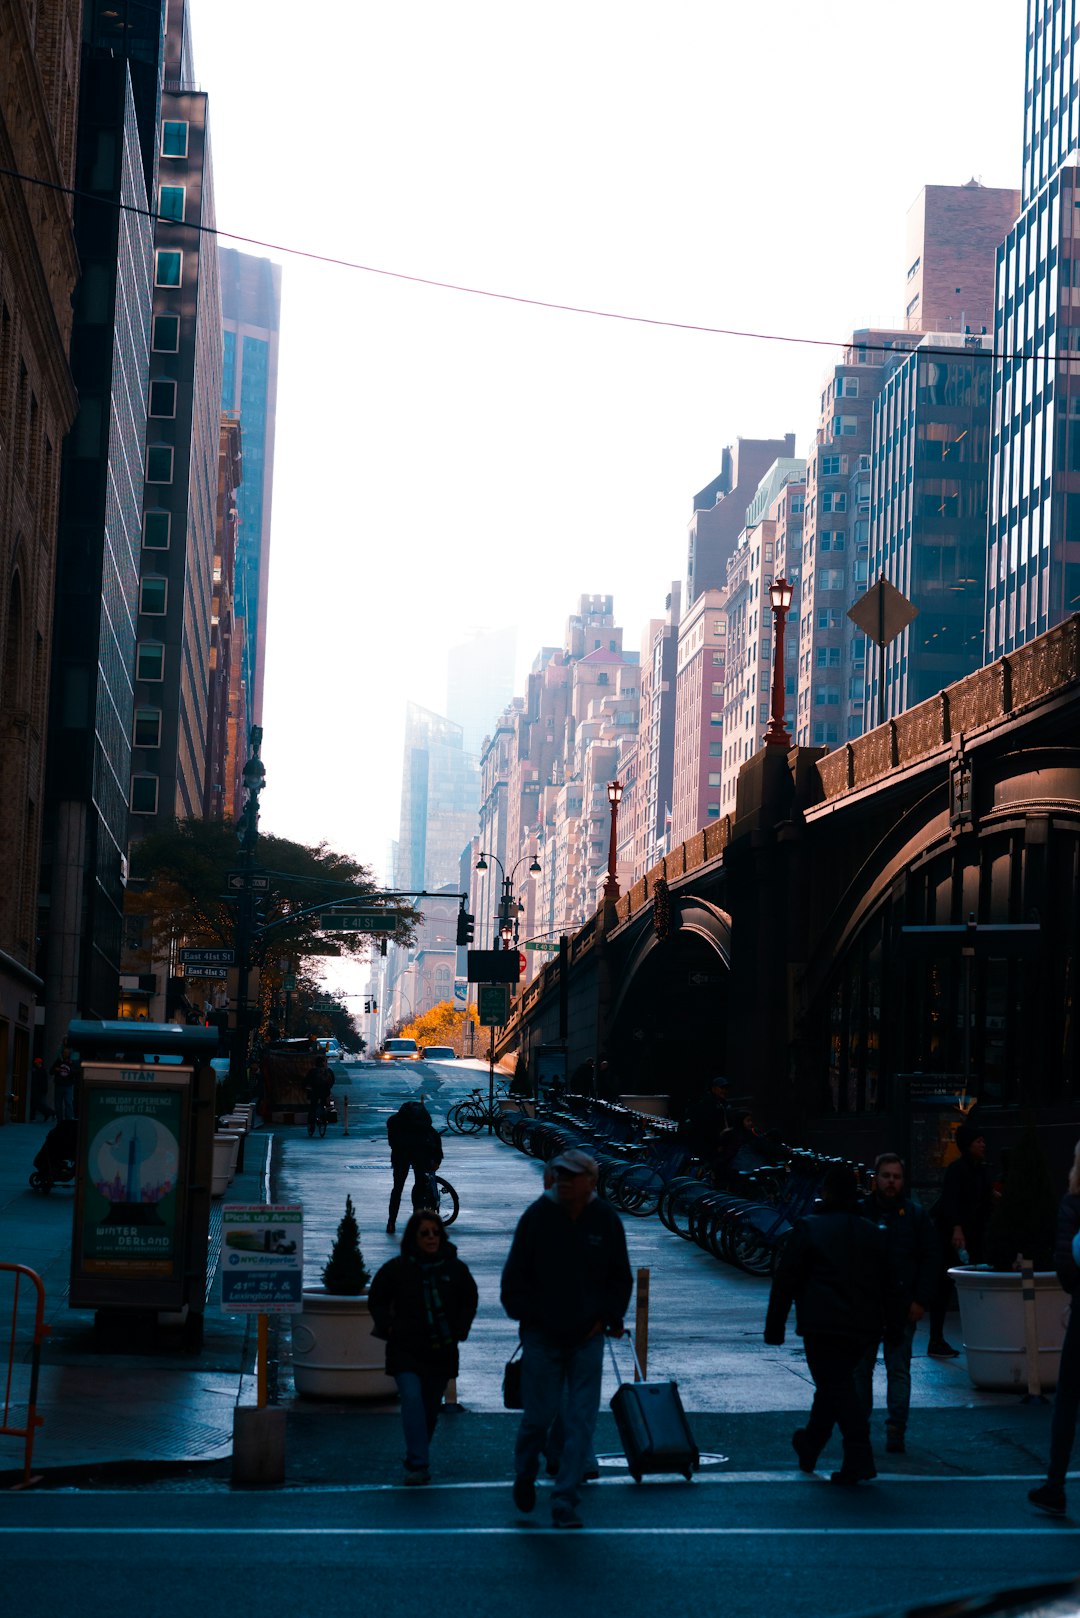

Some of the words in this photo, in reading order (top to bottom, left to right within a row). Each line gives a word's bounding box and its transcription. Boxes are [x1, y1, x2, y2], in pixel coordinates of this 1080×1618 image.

[343, 918, 348, 928] E
[352, 918, 361, 928] 41
[364, 918, 374, 928] St
[184, 952, 200, 961] East
[204, 952, 220, 961] 41st
[222, 952, 231, 961] St
[188, 967, 203, 975] East
[204, 968, 218, 976] 41st
[218, 968, 227, 977] St
[120, 1070, 155, 1081] TITAN
[105, 1097, 132, 1105] HOLIDAY
[133, 1097, 172, 1106] EXPERIENCE
[115, 1105, 135, 1113] ABOVE
[137, 1105, 143, 1113] IT
[225, 1213, 251, 1222] Pick
[254, 1215, 269, 1223] up
[271, 1213, 301, 1222] Area
[96, 1227, 138, 1236] WINTER
[118, 1237, 170, 1246] DERLAND
[258, 1256, 296, 1264] Airporter
[233, 1281, 256, 1290] 41st
[259, 1281, 277, 1290] St.
[281, 1281, 291, 1290] &
[229, 1292, 273, 1301] Lexington
[274, 1292, 294, 1300] Ave.
